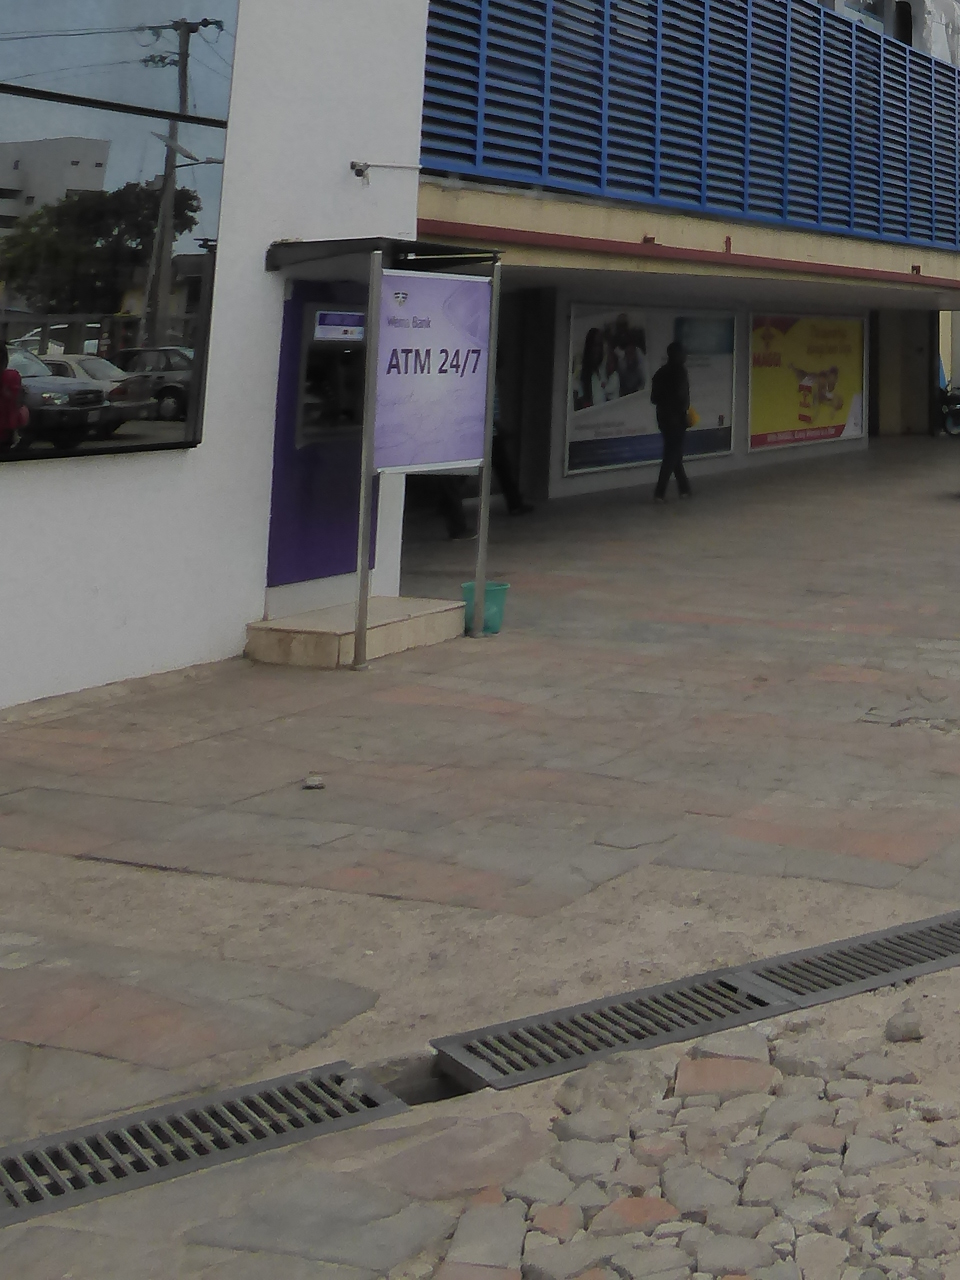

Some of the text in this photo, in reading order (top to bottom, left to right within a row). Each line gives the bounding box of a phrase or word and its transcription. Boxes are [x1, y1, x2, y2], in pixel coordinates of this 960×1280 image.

[412, 315, 431, 330] Bank
[386, 348, 482, 378] ATM 24/7
